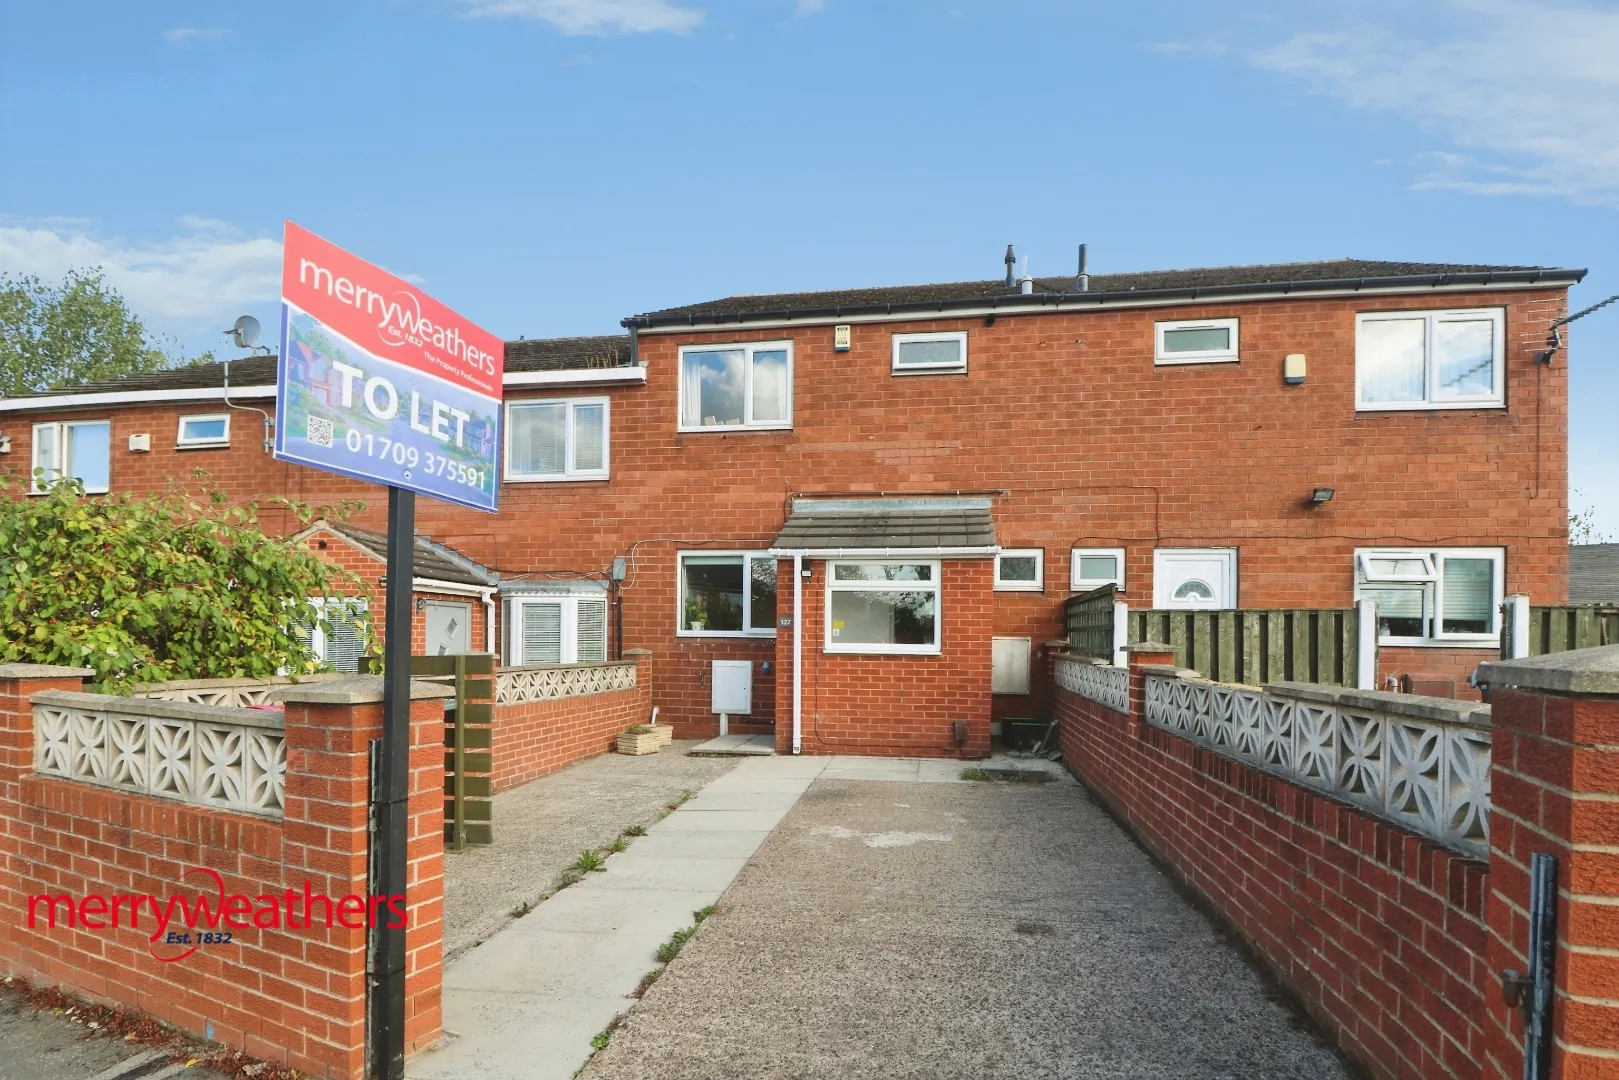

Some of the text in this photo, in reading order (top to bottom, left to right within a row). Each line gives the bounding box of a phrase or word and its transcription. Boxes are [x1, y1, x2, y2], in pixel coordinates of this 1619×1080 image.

[300, 257, 496, 376] merryweathers
[387, 325, 424, 348] Est. 1832
[423, 351, 494, 392] The Property Professionals
[332, 360, 470, 448] TO LET
[345, 428, 486, 490] 01709 375591
